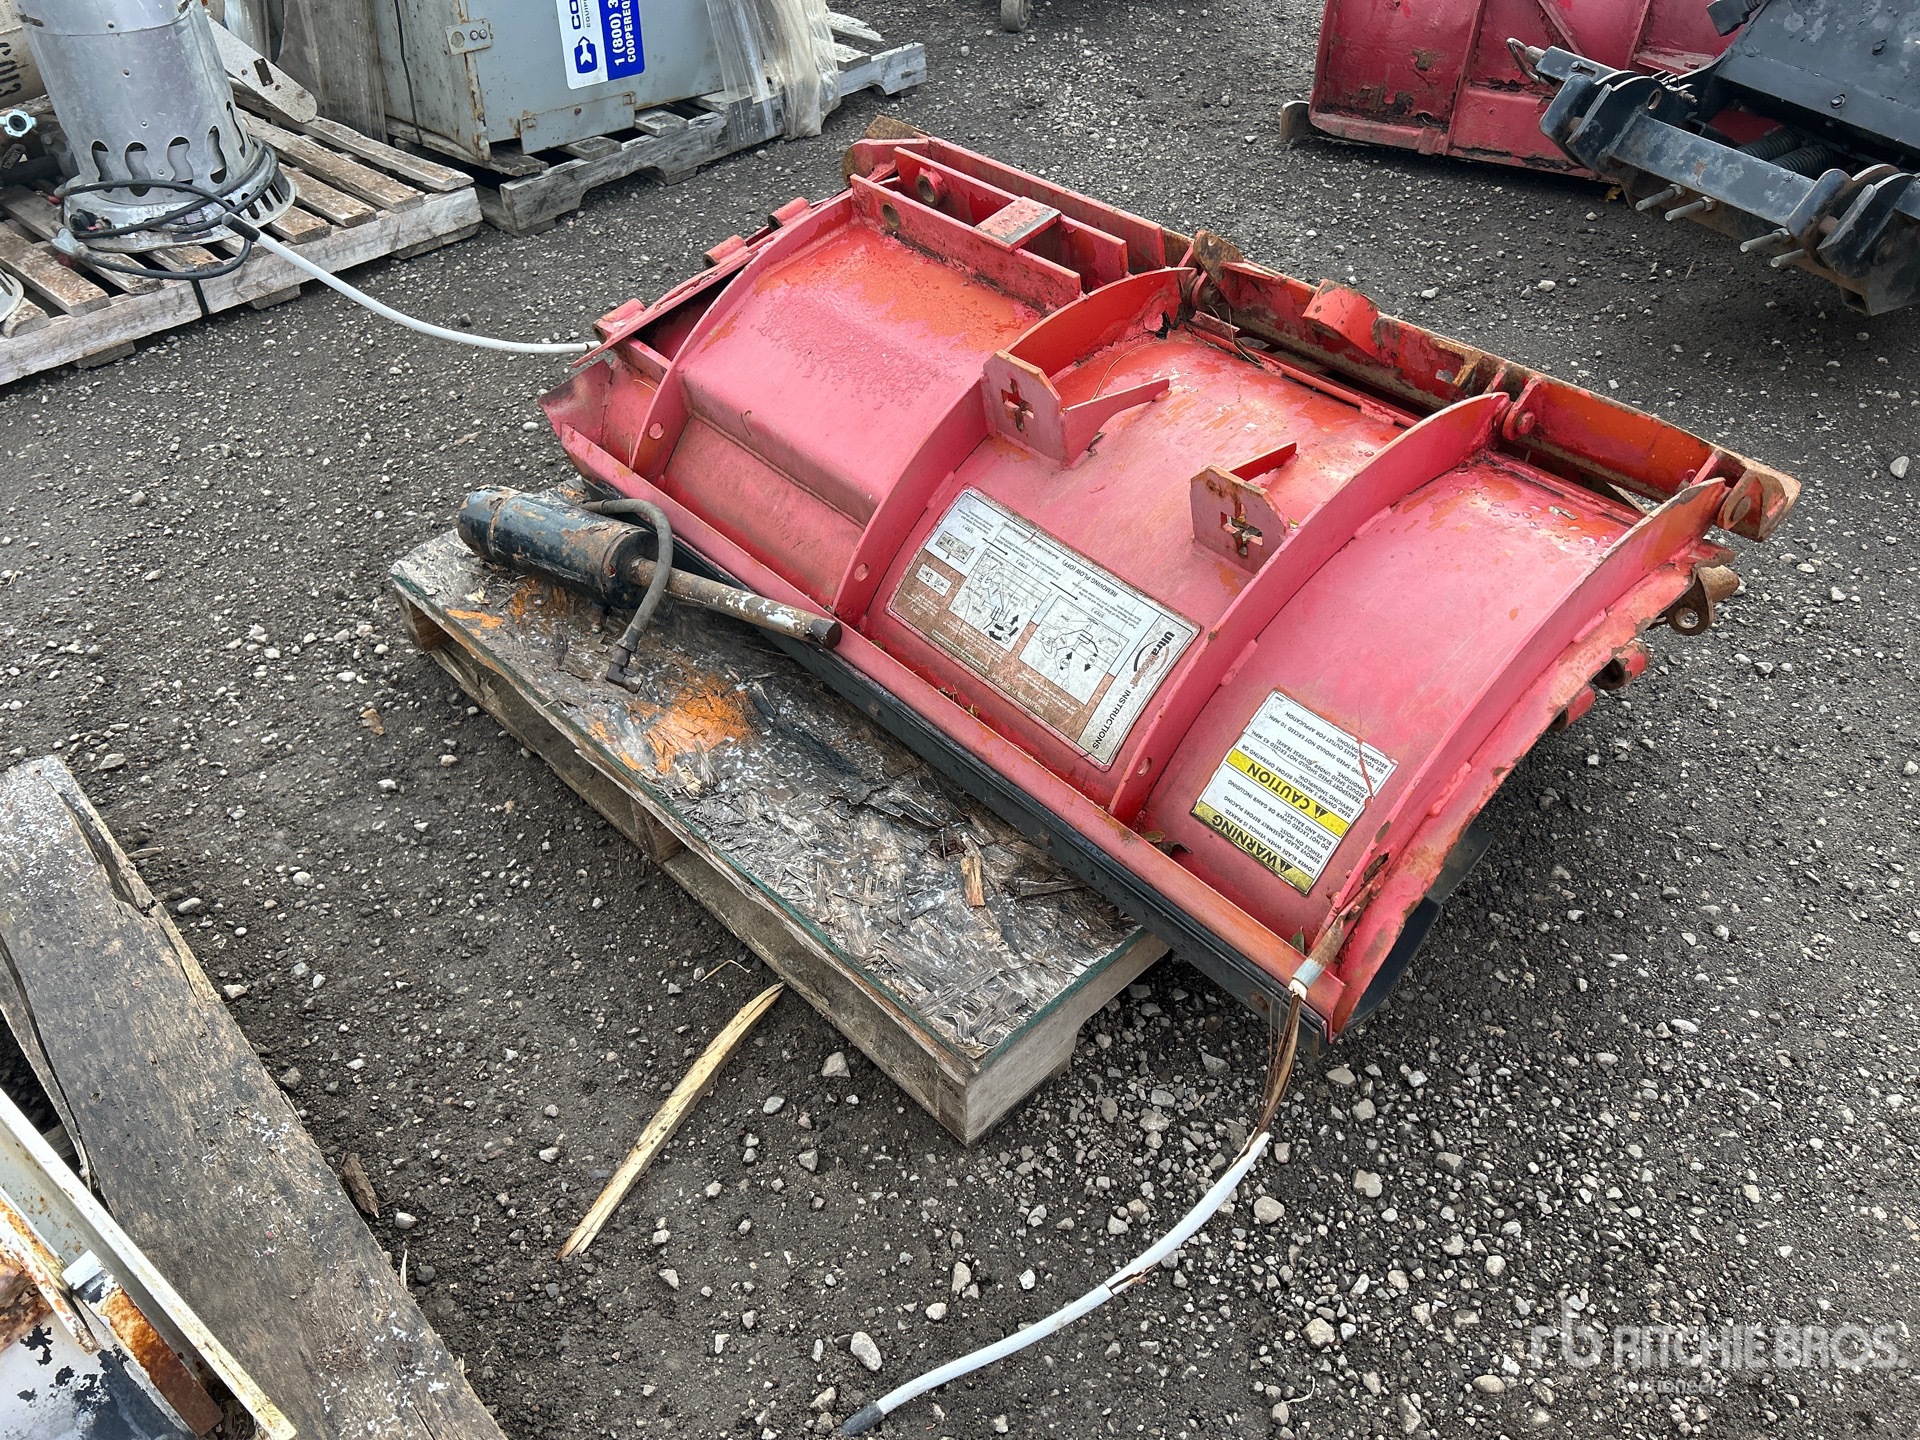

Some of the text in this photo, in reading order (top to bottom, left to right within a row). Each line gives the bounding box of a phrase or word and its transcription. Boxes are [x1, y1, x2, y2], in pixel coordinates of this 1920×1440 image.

[569, 0, 581, 30] CO
[583, 0, 591, 28] EQUIP
[608, 13, 626, 54] (800)
[621, 0, 637, 63] COOPEREQ
[614, 57, 625, 66] 1
[1060, 558, 1118, 597] REMOVING PLOW (OFF)
[1092, 688, 1131, 750] INSTRUCTIONS
[1266, 713, 1281, 724] MPH.
[1284, 711, 1316, 732] APPLICATION
[1249, 729, 1263, 739] MPH.
[1286, 726, 1305, 739] EXCEED
[1314, 730, 1326, 739] FOR
[1241, 743, 1249, 751] OR
[1269, 741, 1287, 755] EXCEED
[1275, 738, 1293, 752] TRAVEL
[1304, 737, 1316, 746] NOT
[1325, 736, 1344, 750] OUTLET
[1248, 748, 1275, 768] OPERATING
[1286, 752, 1298, 762] NOT
[1315, 743, 1336, 759] SHOULD
[1343, 747, 1359, 759] SALES
[1297, 759, 1318, 775] SHOULD
[1313, 763, 1331, 777] UNDER
[1335, 756, 1351, 769] SPEED
[1375, 766, 1385, 774] SEE
[1274, 765, 1293, 780] BEFORE
[1317, 772, 1333, 785] SPEED
[1330, 774, 1346, 786] SPEED
[1245, 762, 1312, 811] CAUTION
[1291, 777, 1314, 794] MANUAL
[1335, 770, 1369, 793] CONDITIONS.
[1296, 773, 1355, 813] SERVICING SNOWPLOW.
[1331, 782, 1362, 803] TRANSPORT
[1345, 784, 1365, 798] REDUCE
[1222, 807, 1243, 823] PARKED.
[1227, 779, 1329, 850] DO NOT EXCEED GVWR OR GAWR INCLUDING
[1336, 806, 1351, 818] READ
[1222, 795, 1321, 864] REMOVE BLADE ASSEMBLY BEFORE PLACING
[1247, 824, 1266, 839] VEHICLE
[1282, 810, 1332, 845] BLADE AND BALLAST.
[1209, 813, 1281, 867] WARNING
[1265, 837, 1282, 850] WHEN
[1278, 826, 1323, 859] VEHICLE ON HOIST.
[1281, 848, 1298, 861] BLADE
[1297, 858, 1315, 873] LOWER
